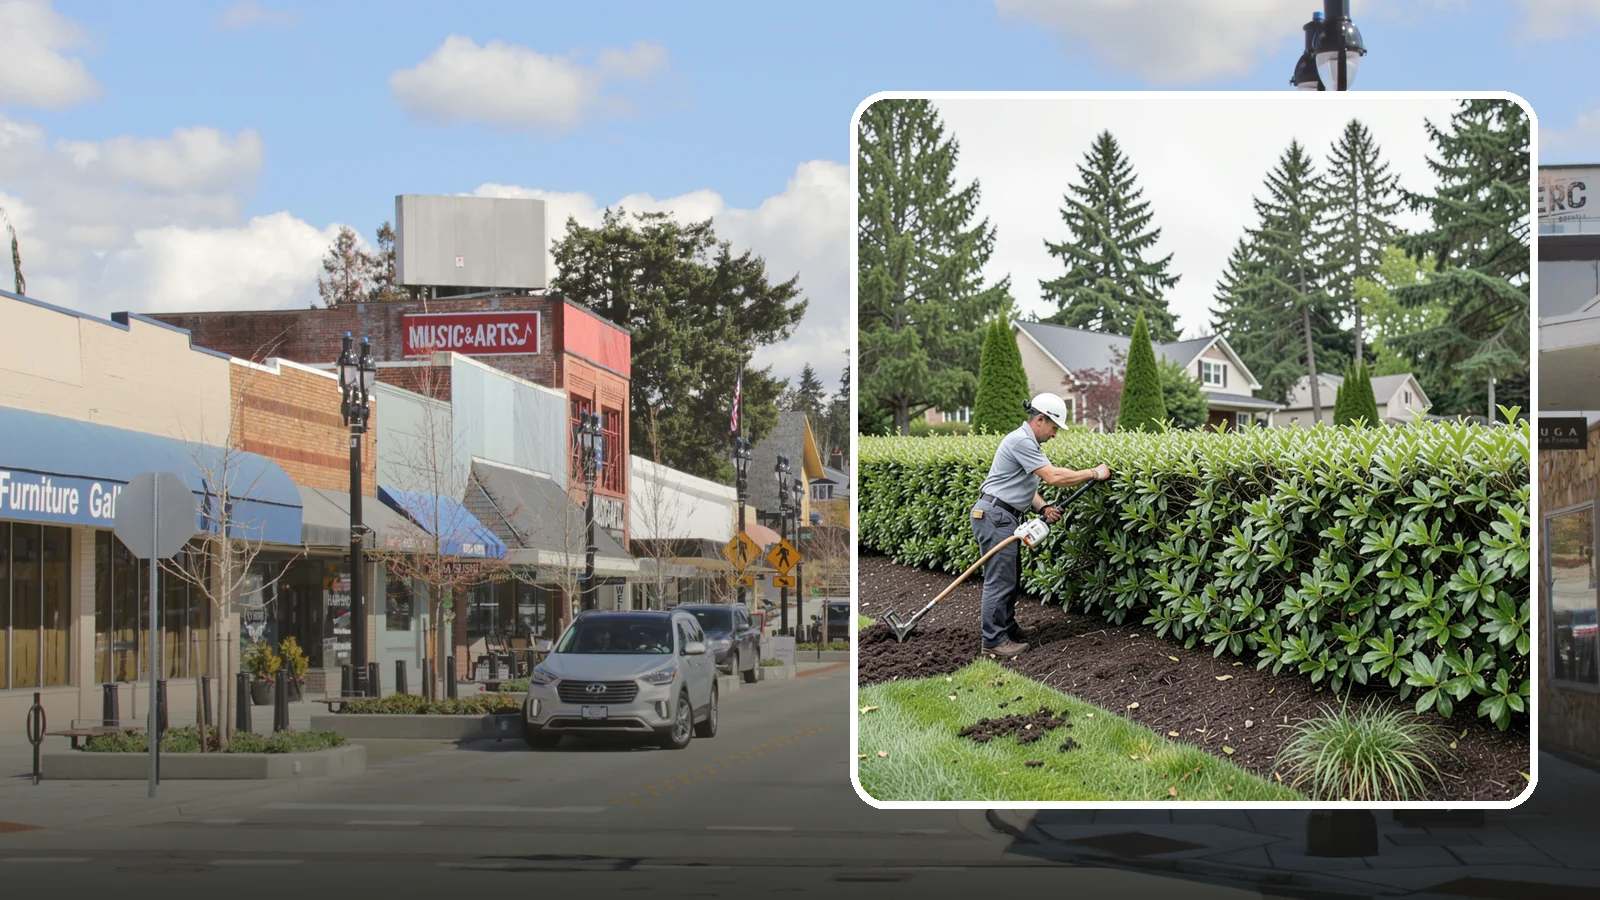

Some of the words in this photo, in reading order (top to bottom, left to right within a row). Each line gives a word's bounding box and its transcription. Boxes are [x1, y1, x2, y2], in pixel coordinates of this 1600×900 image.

[409, 323, 520, 348] MUSIC&ARTS
[1540, 427, 1578, 436] UGA
[0, 471, 79, 515] Furniture
[453, 562, 480, 574] SUSHI
